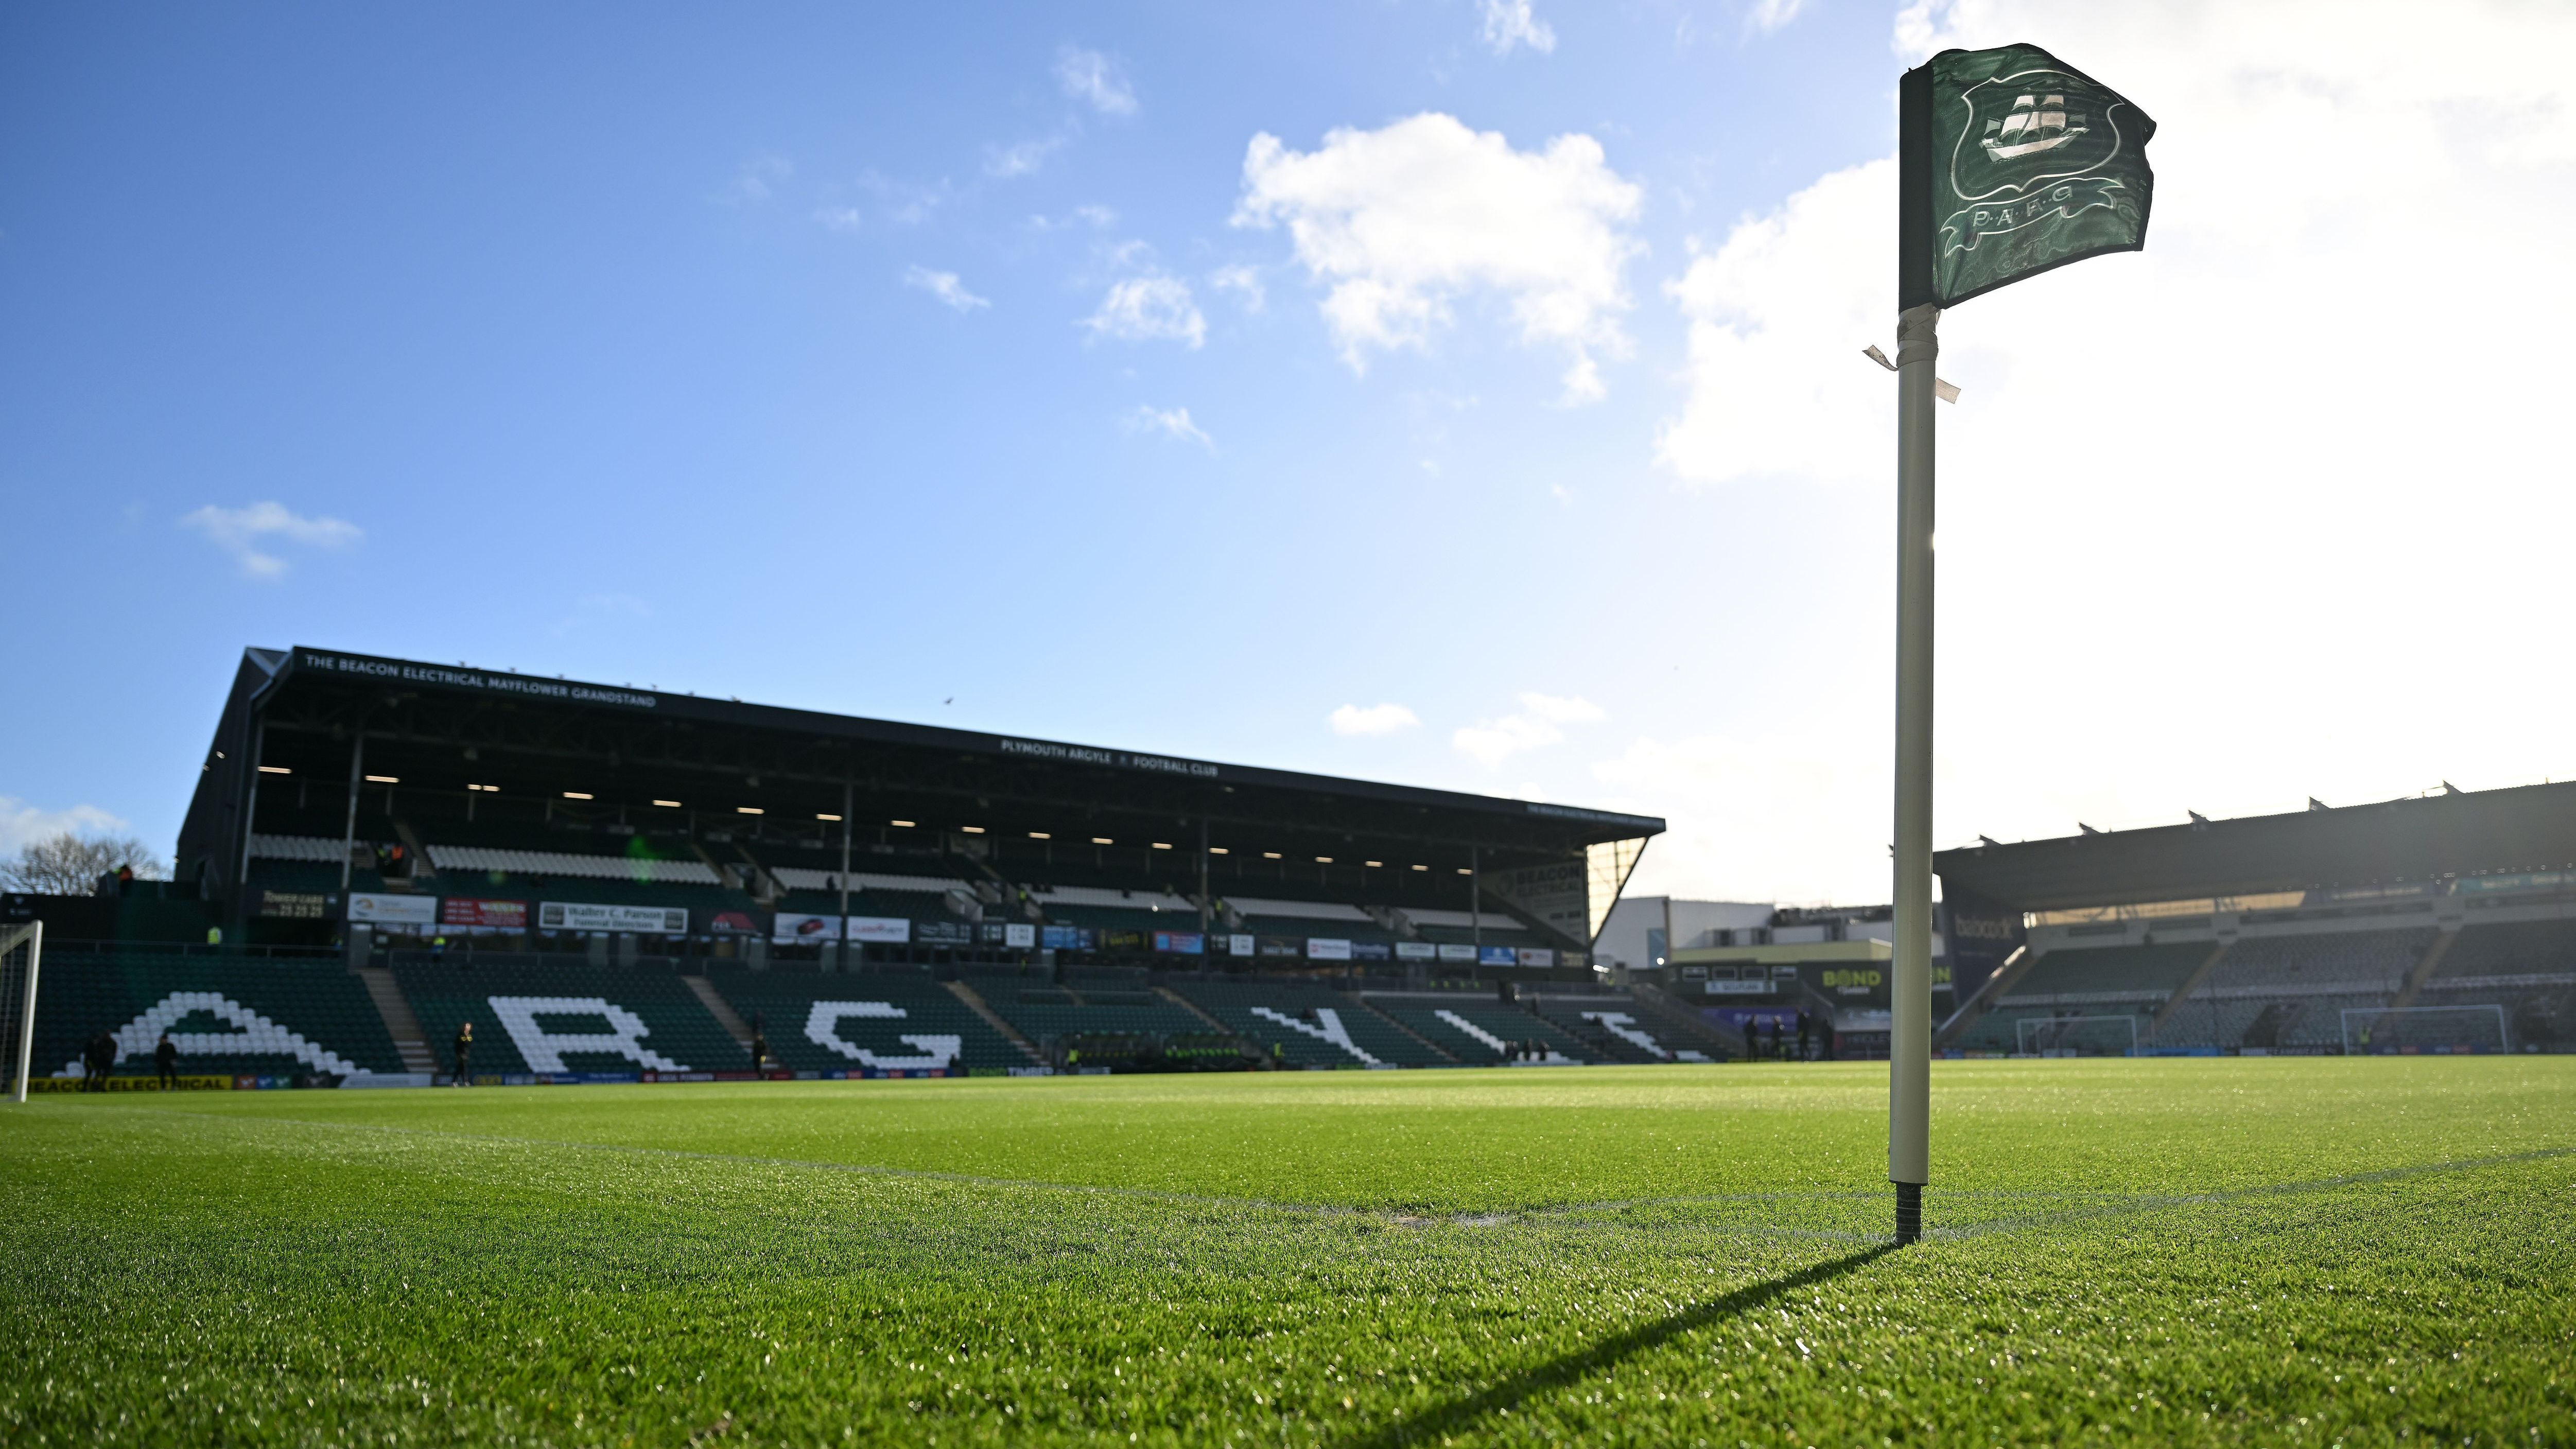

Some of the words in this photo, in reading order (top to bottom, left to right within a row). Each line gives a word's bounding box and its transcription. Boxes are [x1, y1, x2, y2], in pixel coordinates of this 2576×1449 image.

[306, 654, 334, 670] THE
[339, 658, 399, 677] BEACON
[404, 666, 484, 687] ELECTRICAL
[489, 677, 568, 696] MAYFLOWER
[572, 687, 656, 708] GRANDSTAND
[1001, 739, 1067, 758] PLYMOUTH
[1069, 746, 1112, 764] ARGYLE
[1133, 756, 1187, 773] FOOTBALL
[1190, 763, 1219, 777] CLUB
[1822, 969, 1882, 987] BOND
